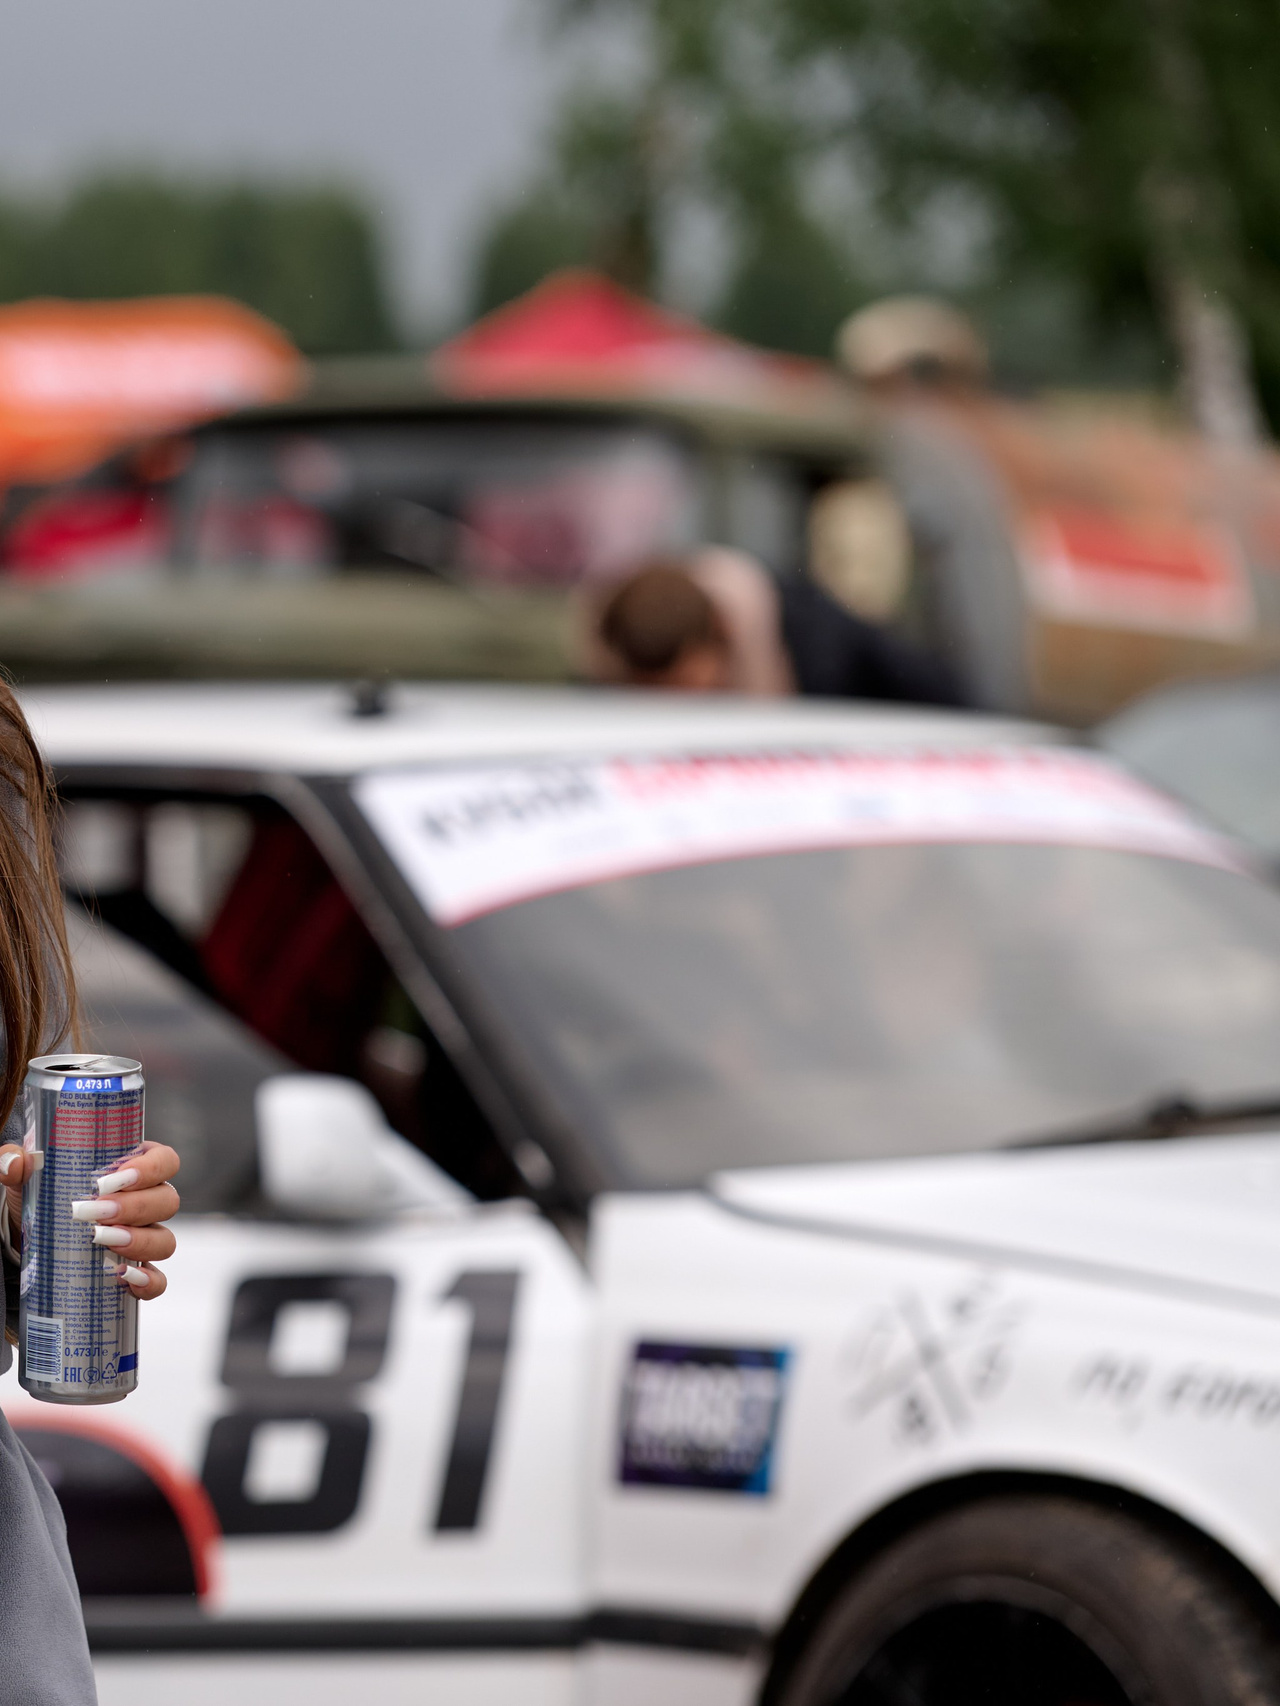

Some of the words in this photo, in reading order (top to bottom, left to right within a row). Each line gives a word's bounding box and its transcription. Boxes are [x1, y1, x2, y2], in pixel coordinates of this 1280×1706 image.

[76, 1080, 102, 1090] 0,473
[104, 1079, 112, 1088] Л
[60, 1092, 72, 1100] RED
[56, 1107, 107, 1115] Безалкогольный
[64, 1347, 91, 1358] 0,473
[198, 1272, 524, 1534] 81
